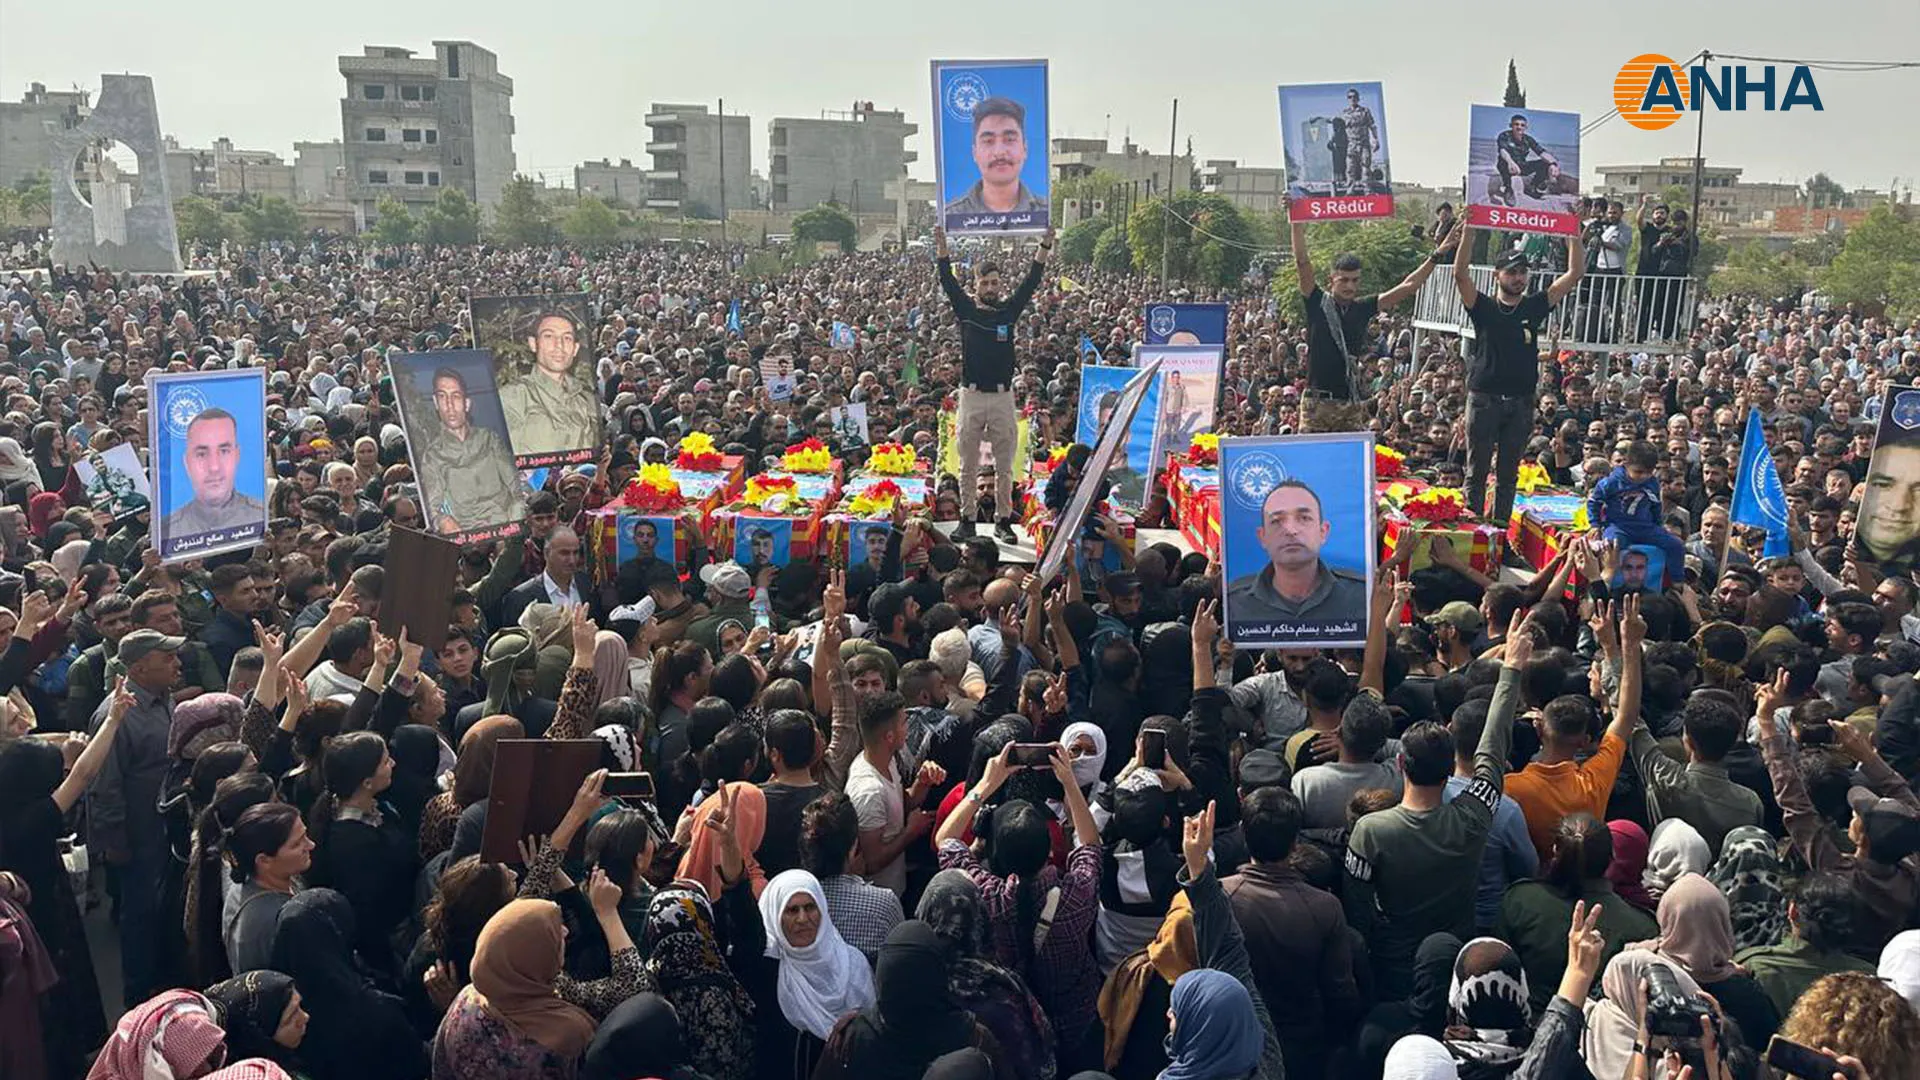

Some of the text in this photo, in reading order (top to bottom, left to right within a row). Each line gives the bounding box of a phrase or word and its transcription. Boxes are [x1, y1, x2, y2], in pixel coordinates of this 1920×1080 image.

[1010, 213, 1031, 225] الشهيد
[230, 525, 255, 539] الشهيد
[1237, 620, 1358, 637] الشهيد بسام حاكم الحسين
